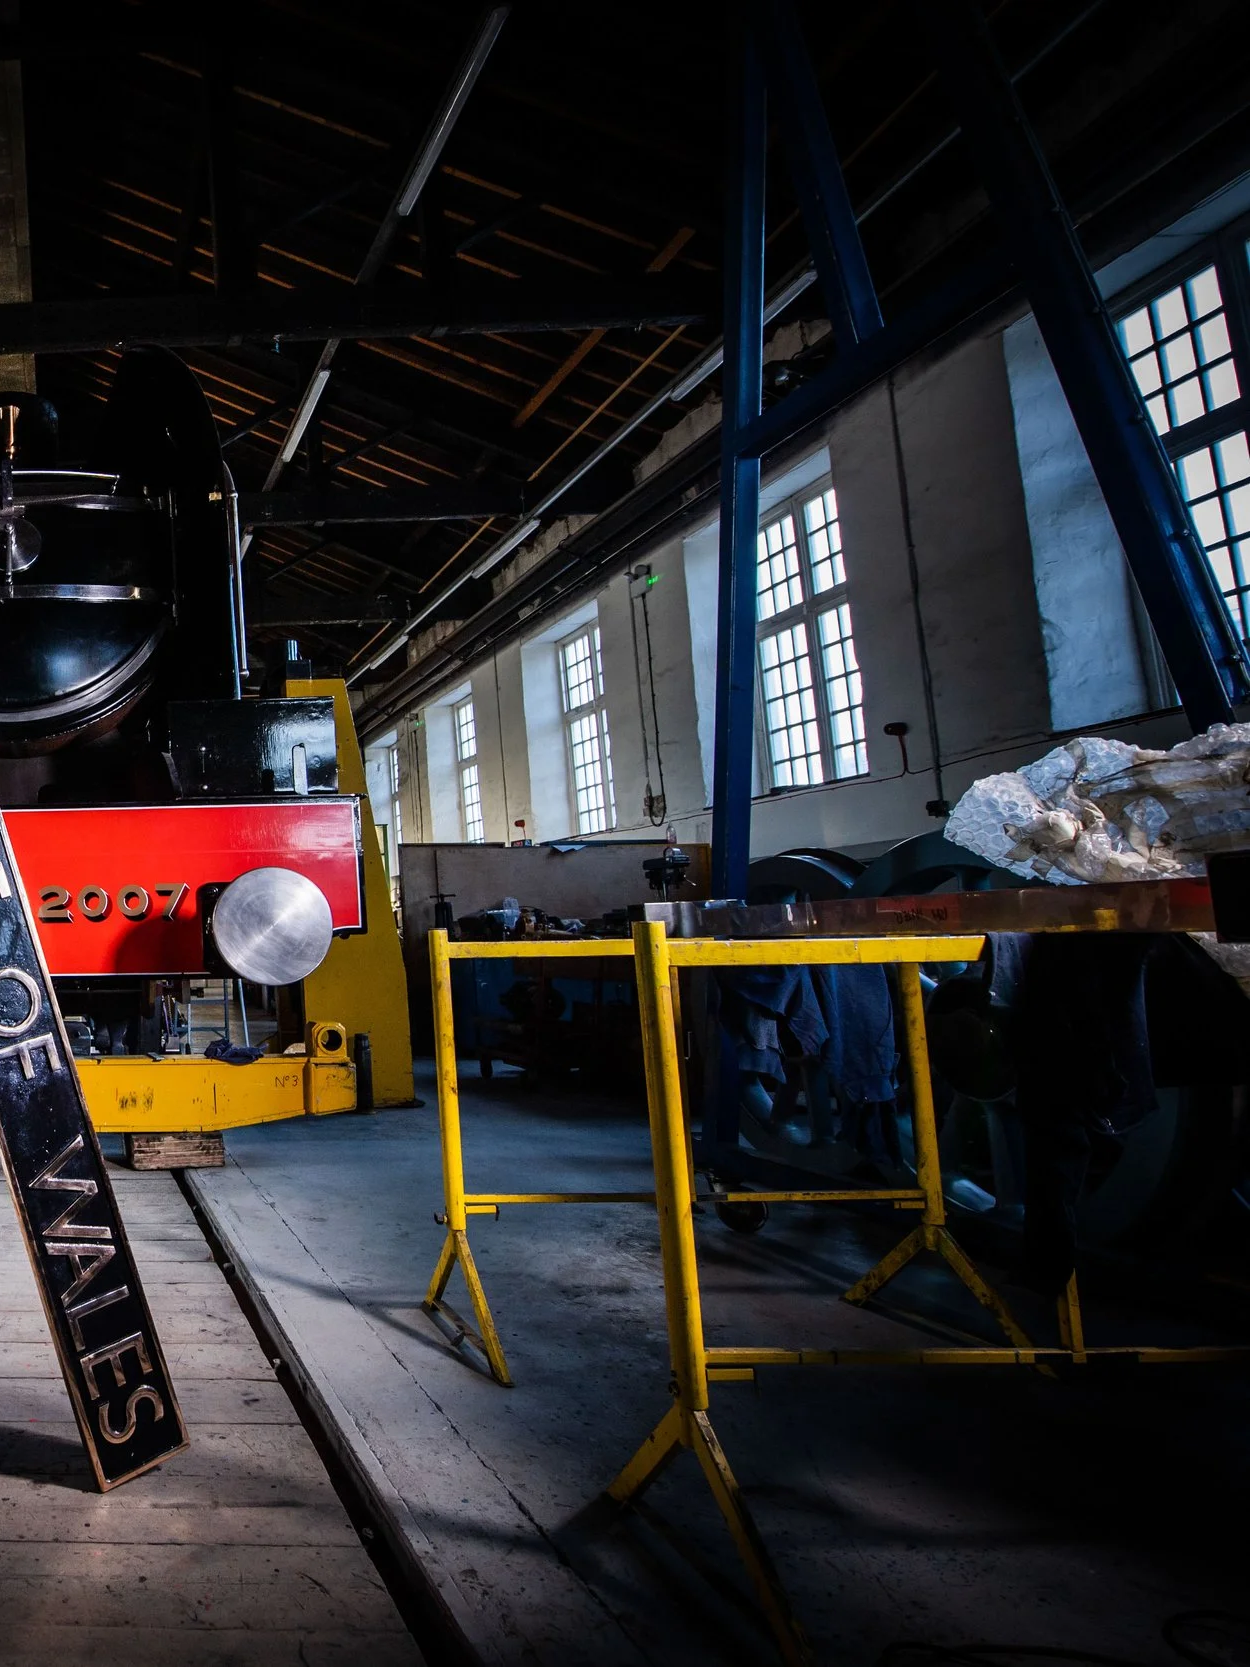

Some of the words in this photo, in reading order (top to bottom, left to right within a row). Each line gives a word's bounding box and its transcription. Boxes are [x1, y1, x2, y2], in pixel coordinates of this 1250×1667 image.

[38, 883, 190, 924] 2007
[292, 1075, 299, 1087] 3
[28, 1133, 165, 1446] WALES
